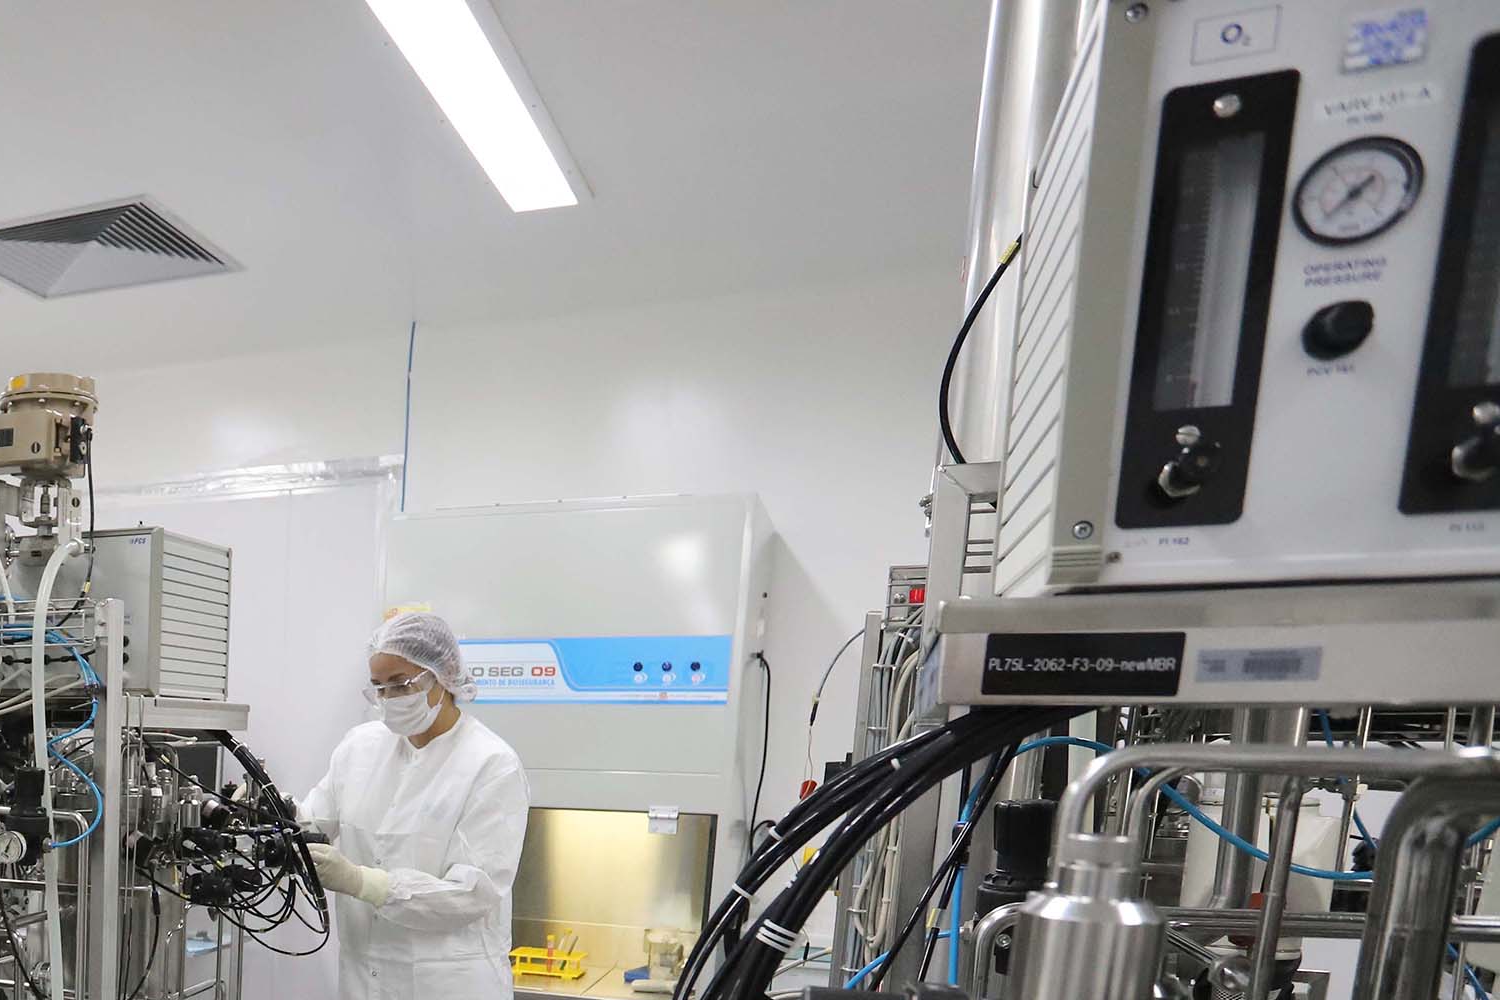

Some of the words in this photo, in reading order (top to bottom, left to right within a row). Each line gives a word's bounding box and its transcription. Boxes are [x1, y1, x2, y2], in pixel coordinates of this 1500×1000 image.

[1305, 270, 1382, 287] PRESSURE
[488, 666, 524, 677] SEG
[531, 666, 556, 677] 09
